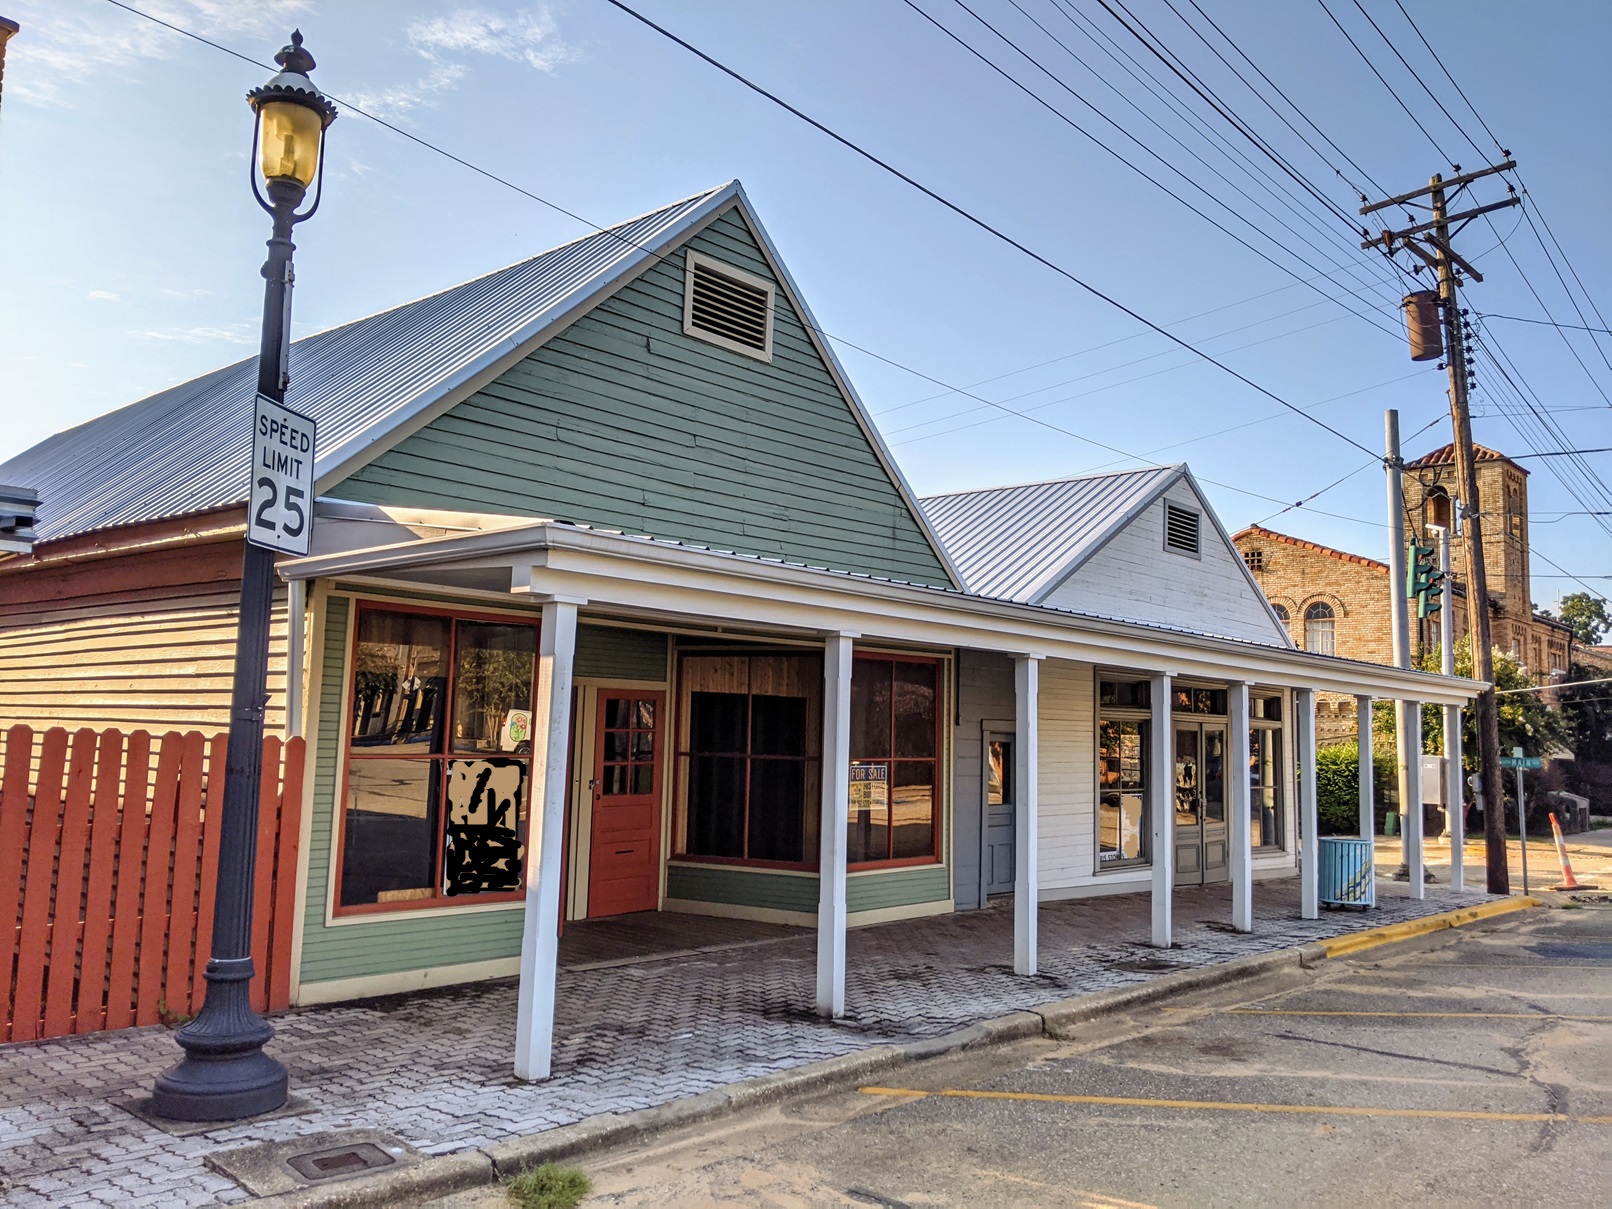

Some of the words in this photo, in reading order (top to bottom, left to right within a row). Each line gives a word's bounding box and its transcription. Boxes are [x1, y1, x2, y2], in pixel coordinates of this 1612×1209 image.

[259, 414, 310, 453] SPEED
[262, 446, 303, 480] LIMIT
[254, 476, 305, 537] 25
[851, 768, 866, 780] FOR
[868, 768, 885, 780] SALE
[1511, 758, 1531, 767] MAIN
